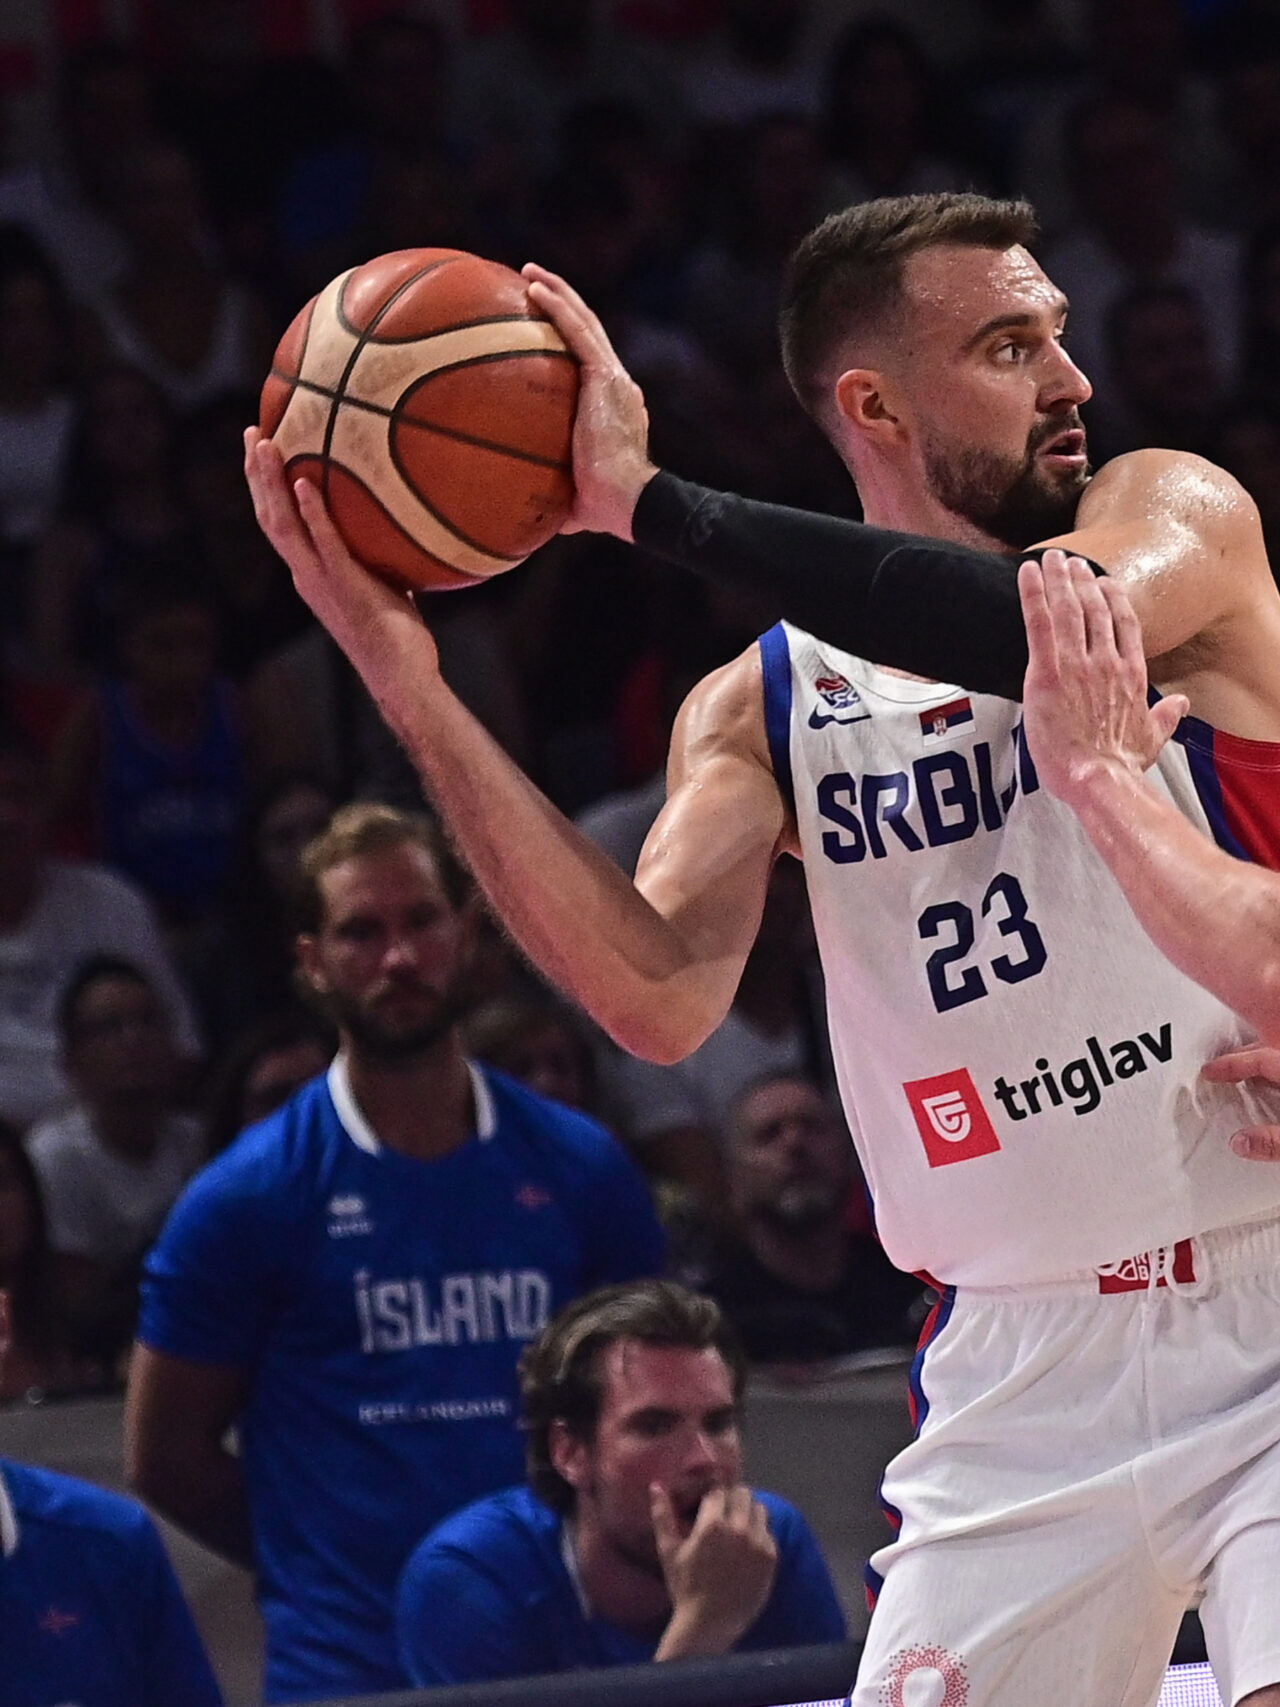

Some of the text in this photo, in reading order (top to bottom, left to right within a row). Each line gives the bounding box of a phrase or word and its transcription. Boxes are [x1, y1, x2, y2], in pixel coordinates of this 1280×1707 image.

[816, 712, 1040, 864] SRBIJ
[917, 871, 1047, 1014] 23
[994, 1022, 1174, 1121] triglav
